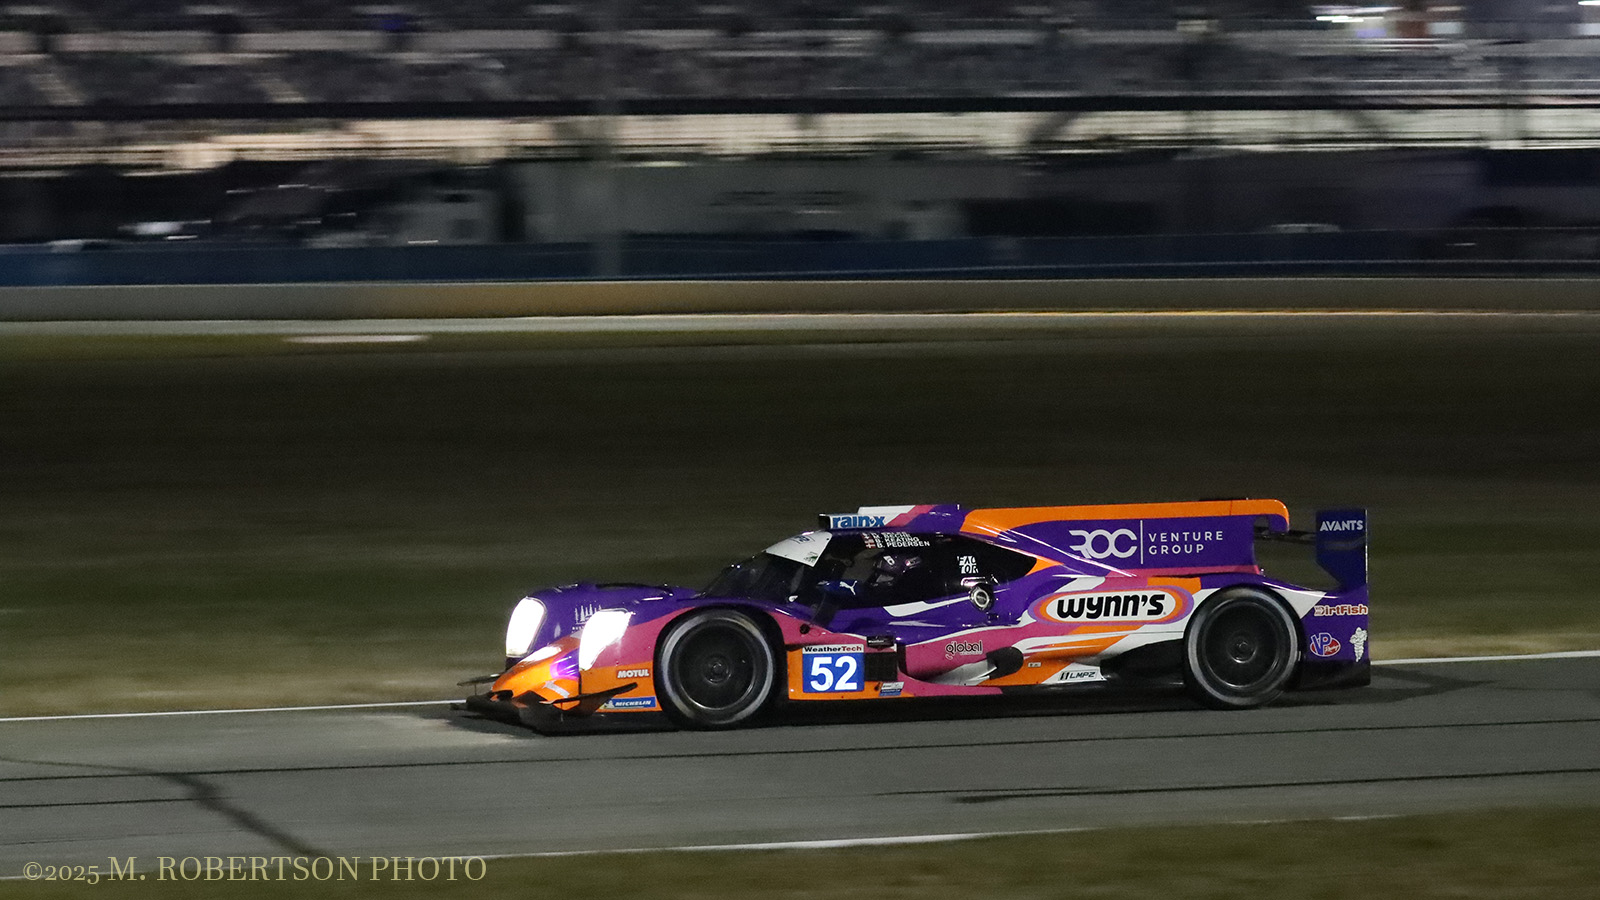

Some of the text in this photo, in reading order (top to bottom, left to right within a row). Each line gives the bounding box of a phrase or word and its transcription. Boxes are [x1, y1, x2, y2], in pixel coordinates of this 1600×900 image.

[1320, 520, 1363, 532] AVANTS
[1069, 528, 1137, 559] ROC
[1148, 531, 1224, 542] VENTURE
[1148, 544, 1204, 555] GROUP
[1056, 594, 1166, 619] wynn's
[804, 645, 862, 653] WeatherTech
[946, 640, 983, 659] global
[1311, 633, 1332, 657] VP
[617, 669, 650, 678] MOTUL
[810, 655, 857, 692] 52
